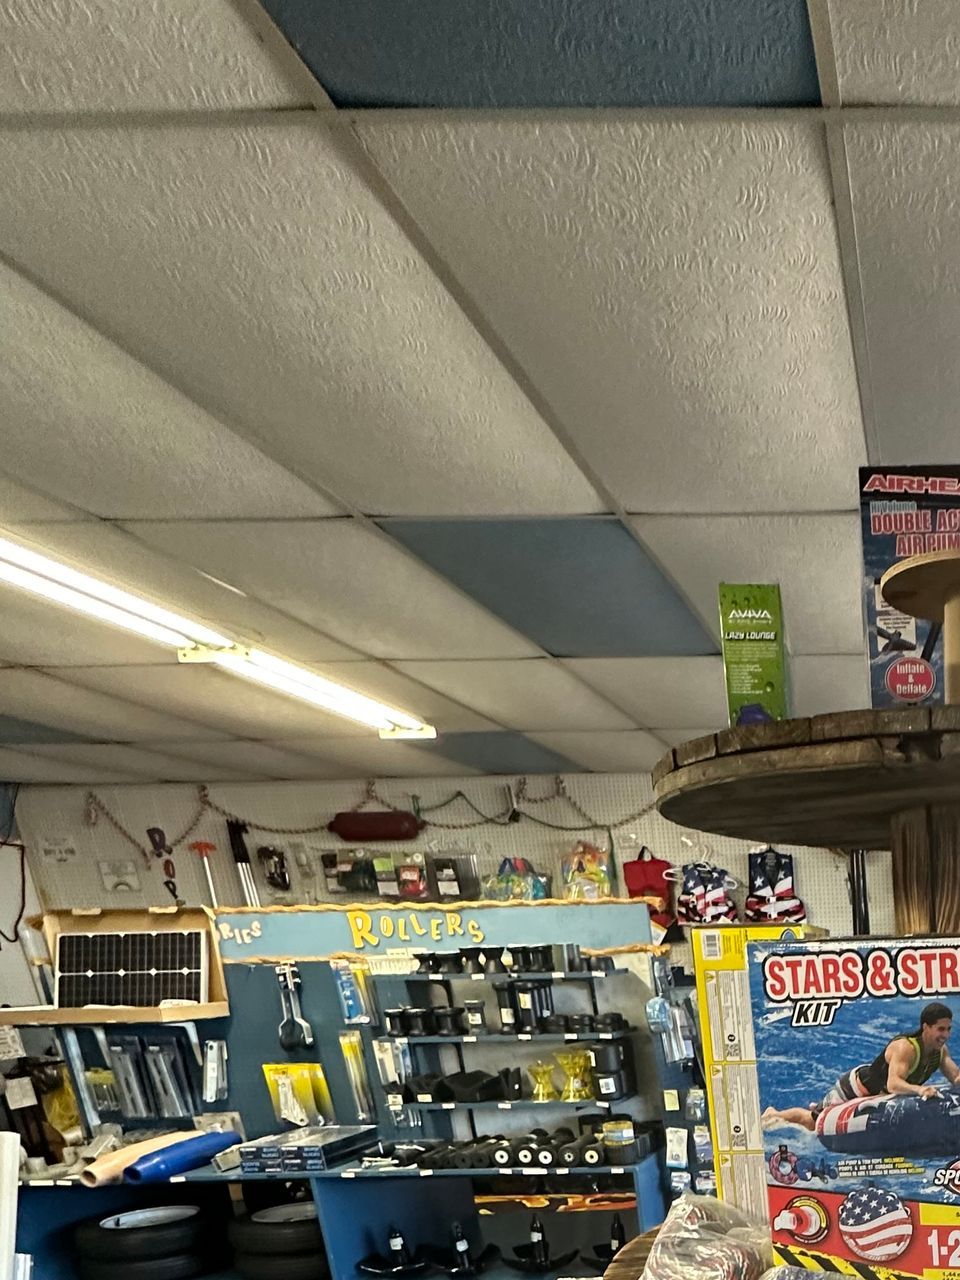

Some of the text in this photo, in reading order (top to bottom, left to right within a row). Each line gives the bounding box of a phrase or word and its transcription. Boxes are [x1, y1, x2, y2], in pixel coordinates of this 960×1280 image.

[871, 509, 932, 535] DOUBLE
[896, 534, 925, 557] AIR
[746, 631, 776, 640] LOUNGE
[897, 664, 925, 674] Inflate
[768, 955, 860, 998] STARS
[870, 955, 892, 991] &
[794, 1002, 838, 1026] KIT
